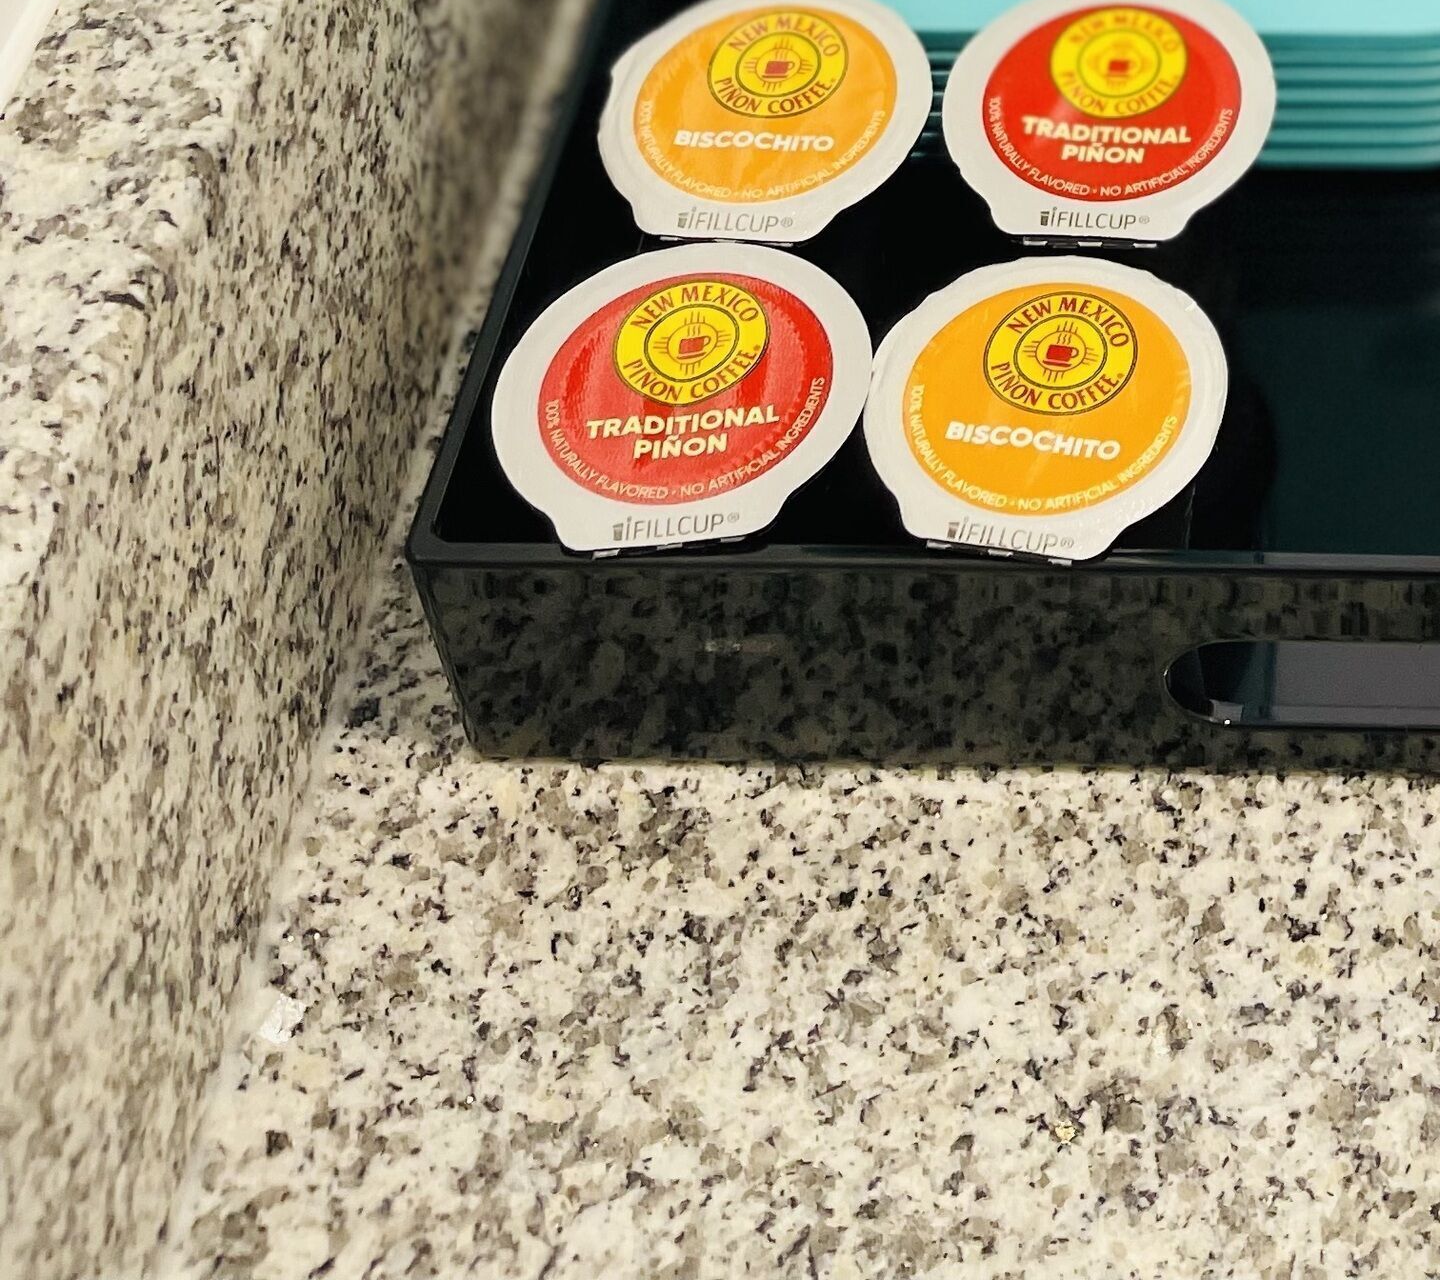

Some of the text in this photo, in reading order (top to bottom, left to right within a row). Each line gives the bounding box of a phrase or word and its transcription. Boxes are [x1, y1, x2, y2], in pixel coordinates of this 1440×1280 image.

[727, 15, 841, 57] NEW MEXICO
[767, 80, 833, 114] COFFEE
[673, 129, 835, 153] BISCOCHITO
[1021, 114, 1192, 145] TRADITIONAL
[641, 125, 676, 178] NATURALLY
[674, 167, 732, 198] FLAVORED
[741, 188, 763, 199] NO
[765, 167, 834, 198] ARTIFICIAL
[831, 109, 887, 170] INGREDIENTS
[991, 121, 1032, 173] NATURALLY
[1026, 166, 1090, 196] FLAVORED
[1100, 184, 1122, 197] NO
[1124, 163, 1190, 196] ARTIFICIAL
[1186, 107, 1234, 171] INGREDIENTS
[1060, 142, 1146, 165] PIÑON
[630, 284, 760, 331] NEW MEXICO
[1005, 295, 1130, 348] NEW MEXICO
[689, 348, 758, 400] COFFEE
[1046, 372, 1121, 410] COFFEE
[549, 427, 598, 482] NATURALLY
[594, 472, 670, 500] FLAVORED
[679, 483, 706, 498] NO
[707, 447, 782, 493] ARTIFICIAL
[775, 375, 826, 452] INGREDIENTS
[585, 403, 781, 441] TRADITIONAL
[944, 419, 1122, 461] BISCOCHITO
[632, 433, 728, 461] PIÑON
[909, 412, 947, 474] NATURALLY
[939, 468, 1009, 508] FLAVORED
[1017, 497, 1043, 512] NO
[1044, 479, 1120, 510] ARTIFICIAL
[1117, 414, 1179, 484] INGREDIENTS
